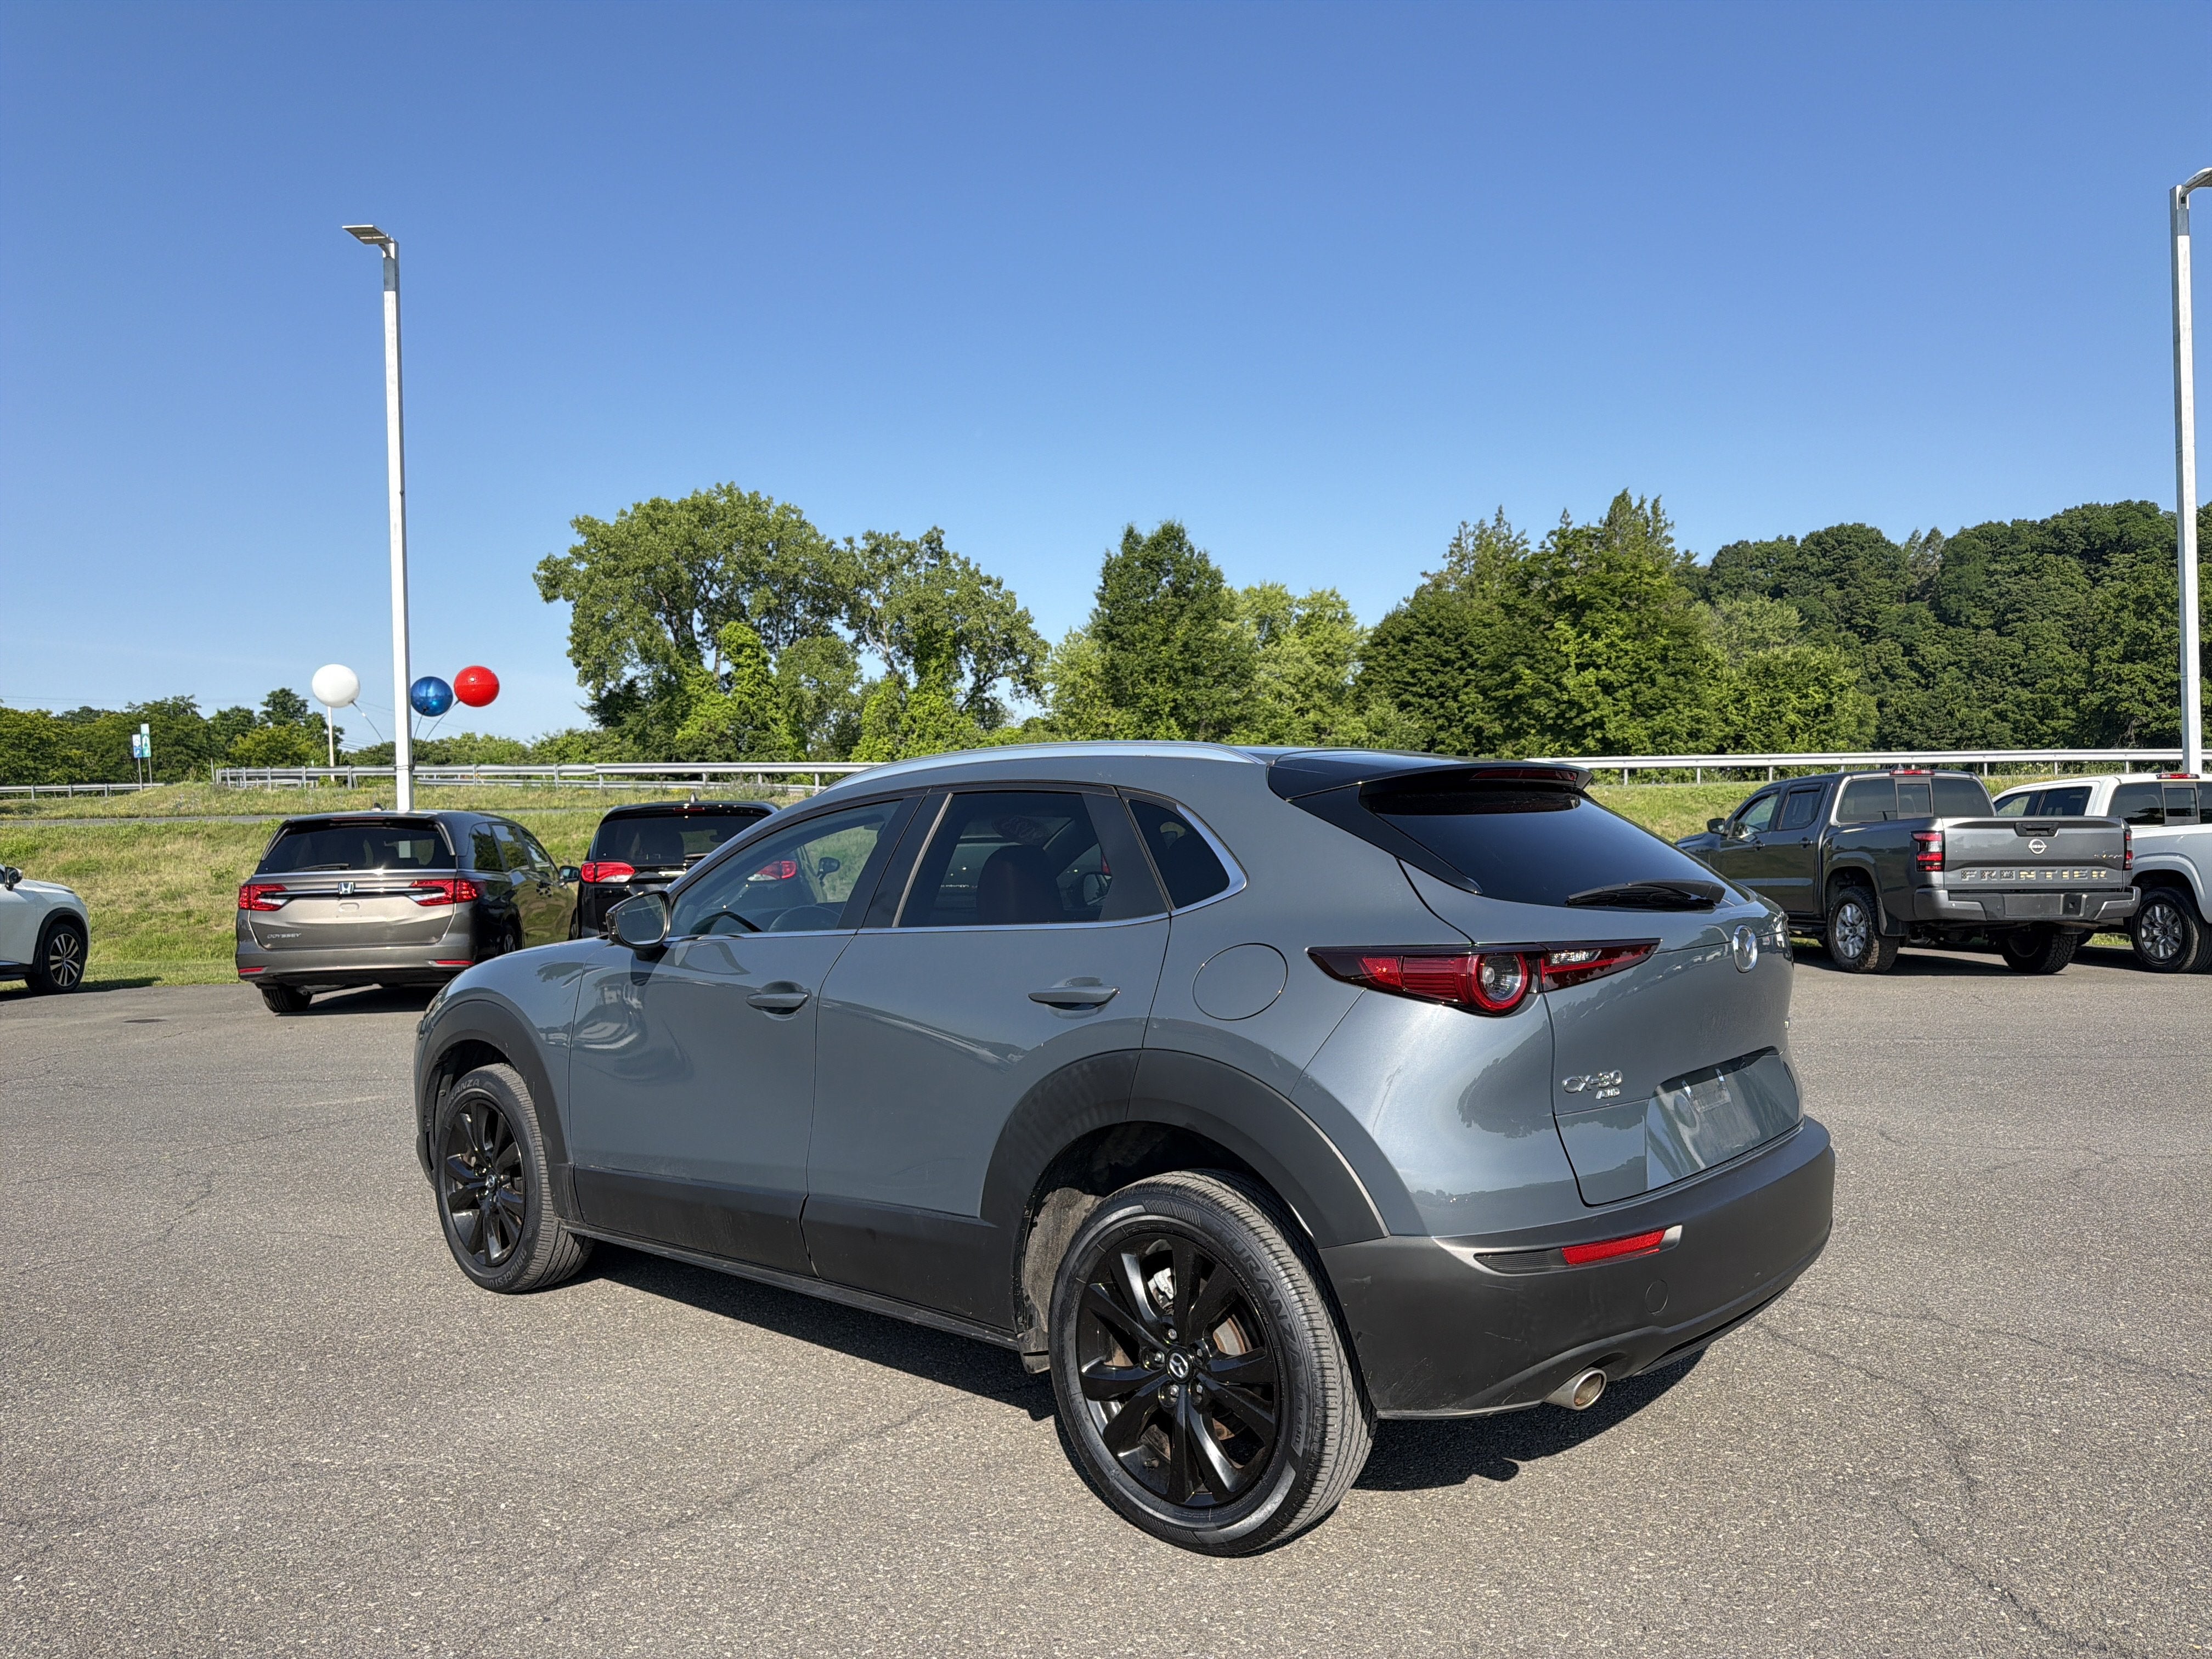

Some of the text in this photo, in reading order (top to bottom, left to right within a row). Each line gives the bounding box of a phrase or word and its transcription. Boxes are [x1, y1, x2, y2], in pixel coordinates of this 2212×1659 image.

[1961, 870, 2107, 881] FRONTIER
[1562, 1070, 1623, 1093] CX-30
[1219, 1229, 1303, 1370] URANZA
